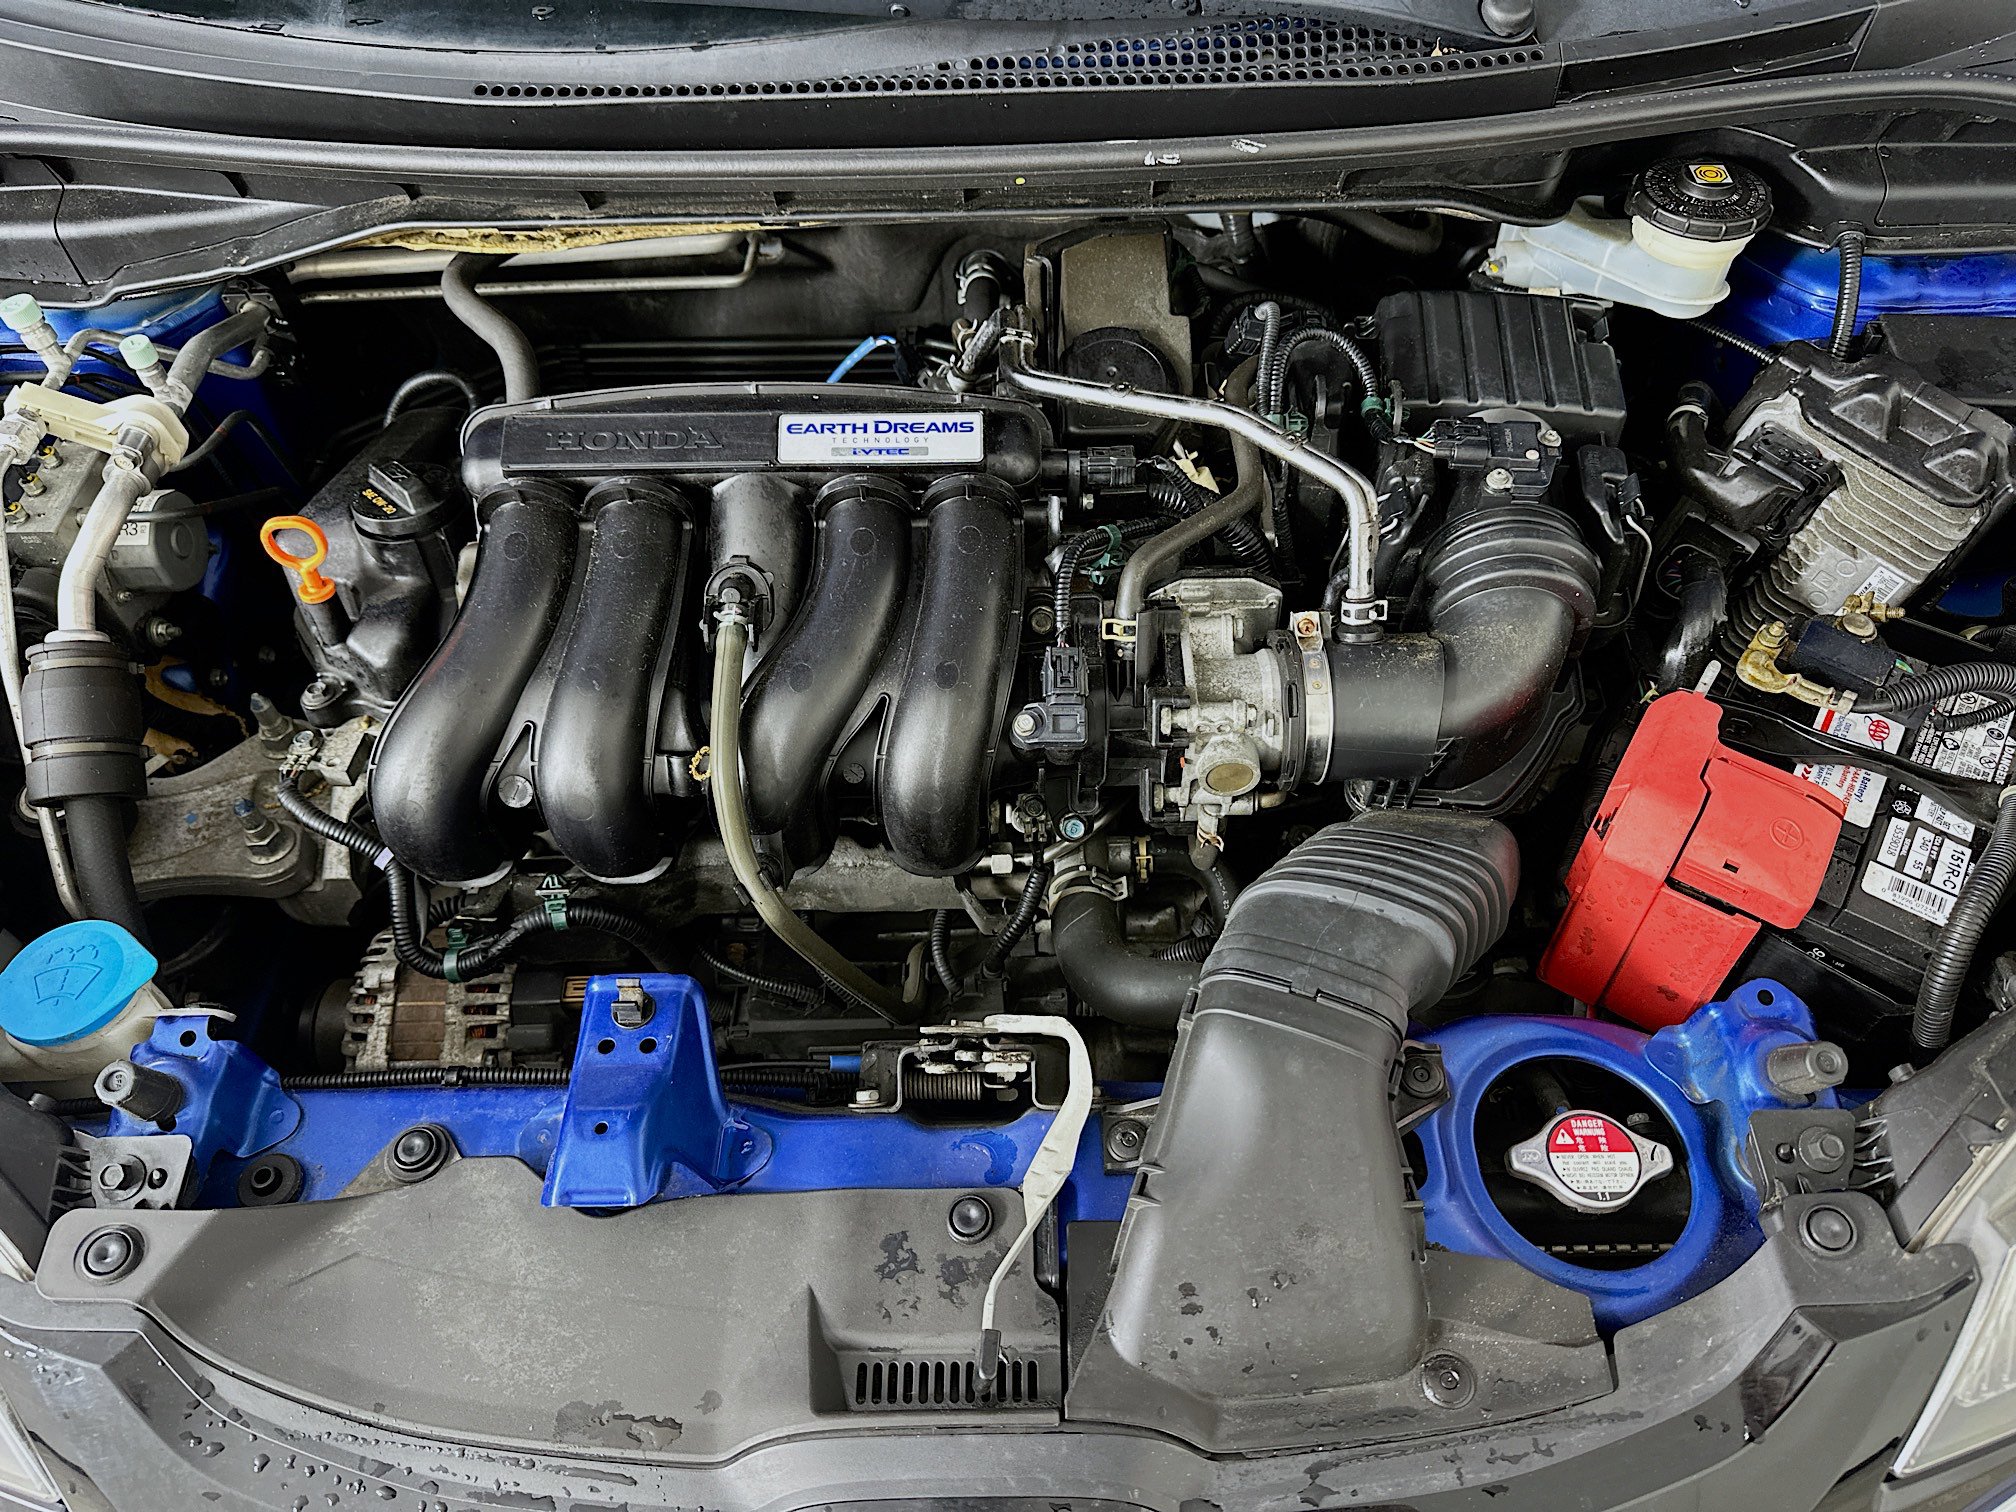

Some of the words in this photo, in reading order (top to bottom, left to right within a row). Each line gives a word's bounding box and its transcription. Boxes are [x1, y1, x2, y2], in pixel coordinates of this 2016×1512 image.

[786, 420, 871, 435] EARTH
[545, 426, 724, 451] HONDA
[832, 436, 930, 444] TECHNOLOGY
[1854, 776, 1871, 802] Battery?
[1886, 823, 1905, 856] 3539018
[1899, 837, 1910, 856] SERIAL
[1919, 836, 1931, 851] 340
[1912, 859, 1923, 870] 55
[1942, 848, 1966, 889] 151R-C
[1571, 1119, 1604, 1127] DANGER
[1573, 1128, 1605, 1136] WARNUNG
[1597, 1192, 1611, 1201] 1.1
